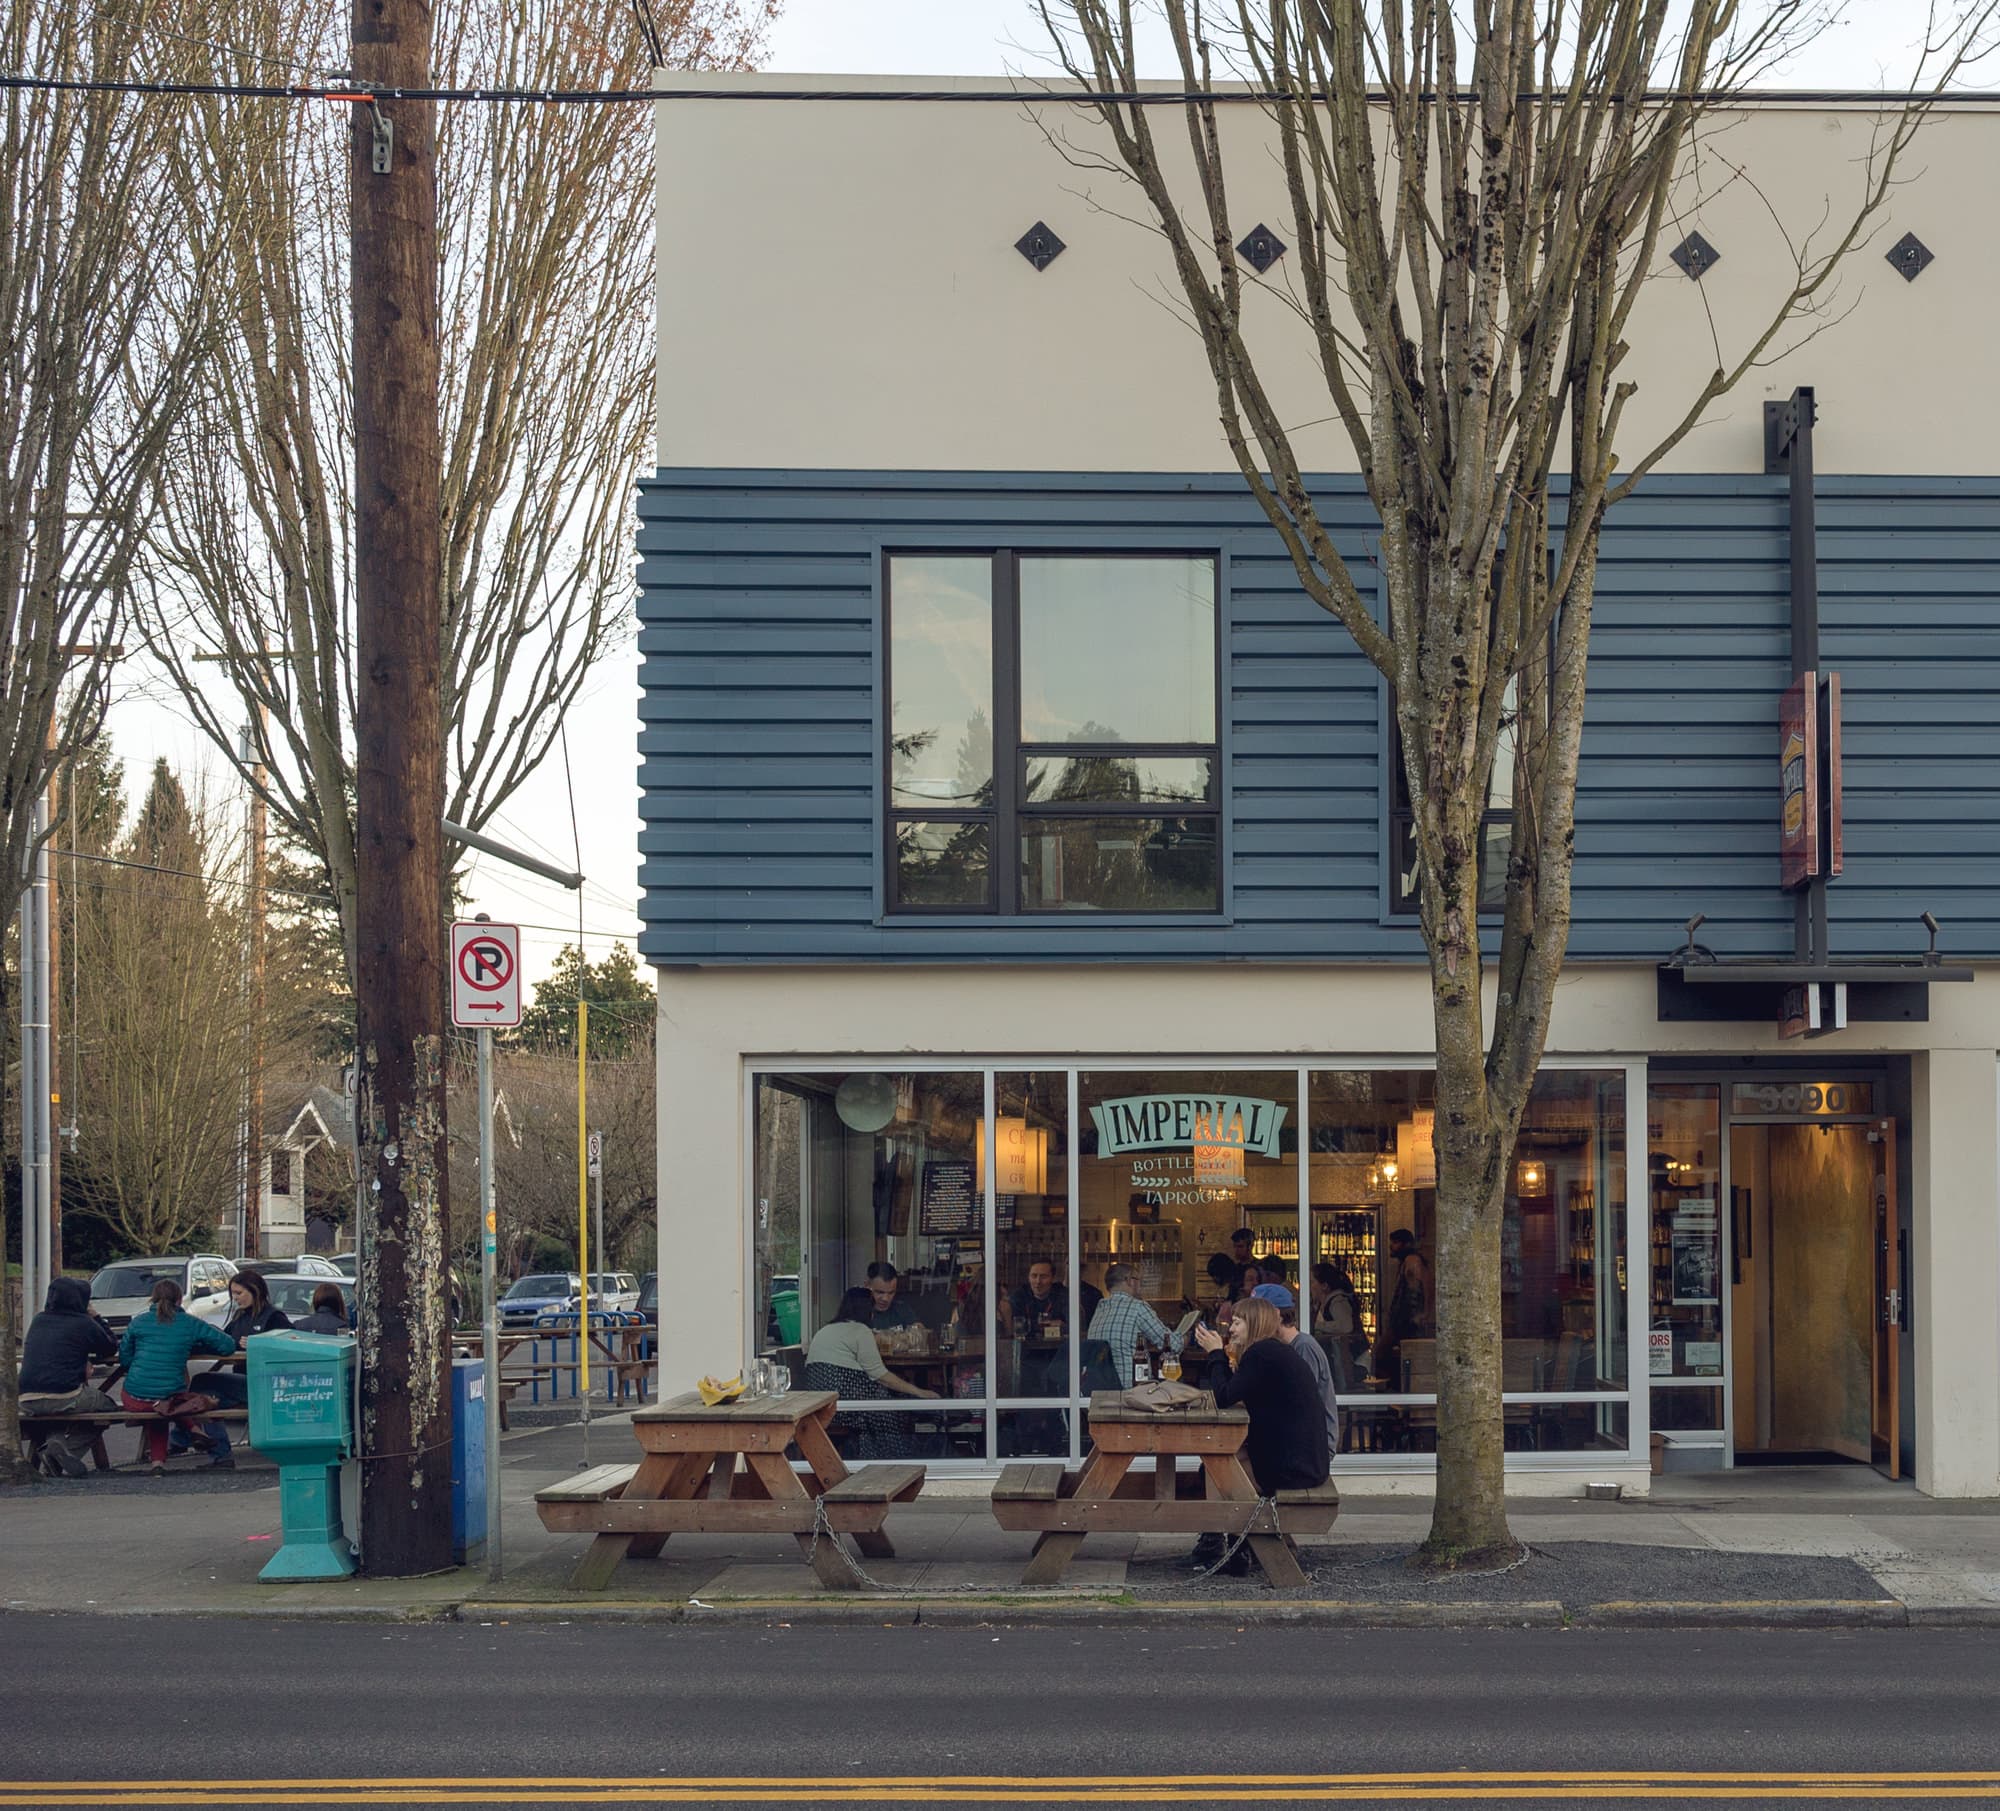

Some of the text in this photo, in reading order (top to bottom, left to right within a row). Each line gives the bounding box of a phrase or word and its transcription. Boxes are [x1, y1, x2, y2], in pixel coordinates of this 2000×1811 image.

[1760, 1086, 1846, 1112] 3090
[1109, 1100, 1264, 1146] IMPERIAL
[1174, 1176, 1196, 1187] AND
[273, 1375, 333, 1388] The Asian
[273, 1389, 333, 1404] Reporter
